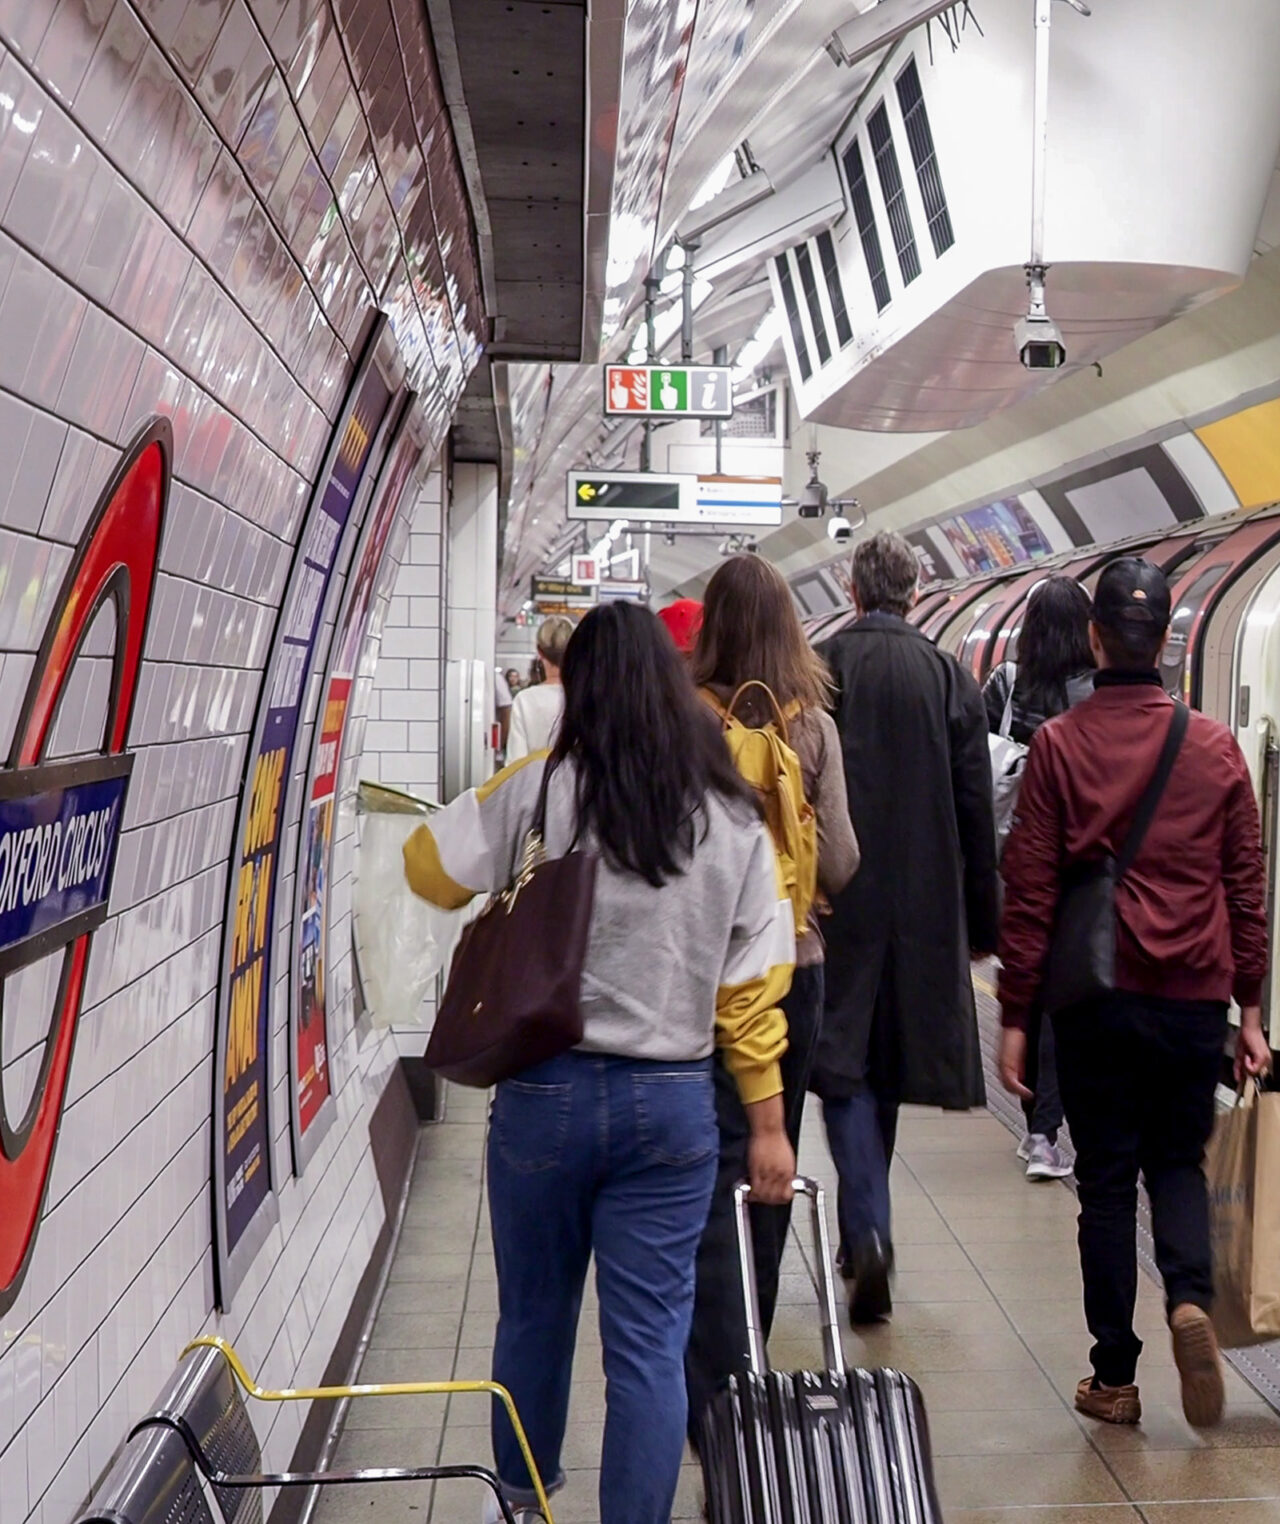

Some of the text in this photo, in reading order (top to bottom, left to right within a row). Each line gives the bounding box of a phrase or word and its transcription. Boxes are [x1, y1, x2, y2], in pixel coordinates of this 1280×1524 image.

[58, 807, 110, 892] CIRCUS
[243, 747, 286, 858] COME
[224, 956, 263, 1094] AWAY
